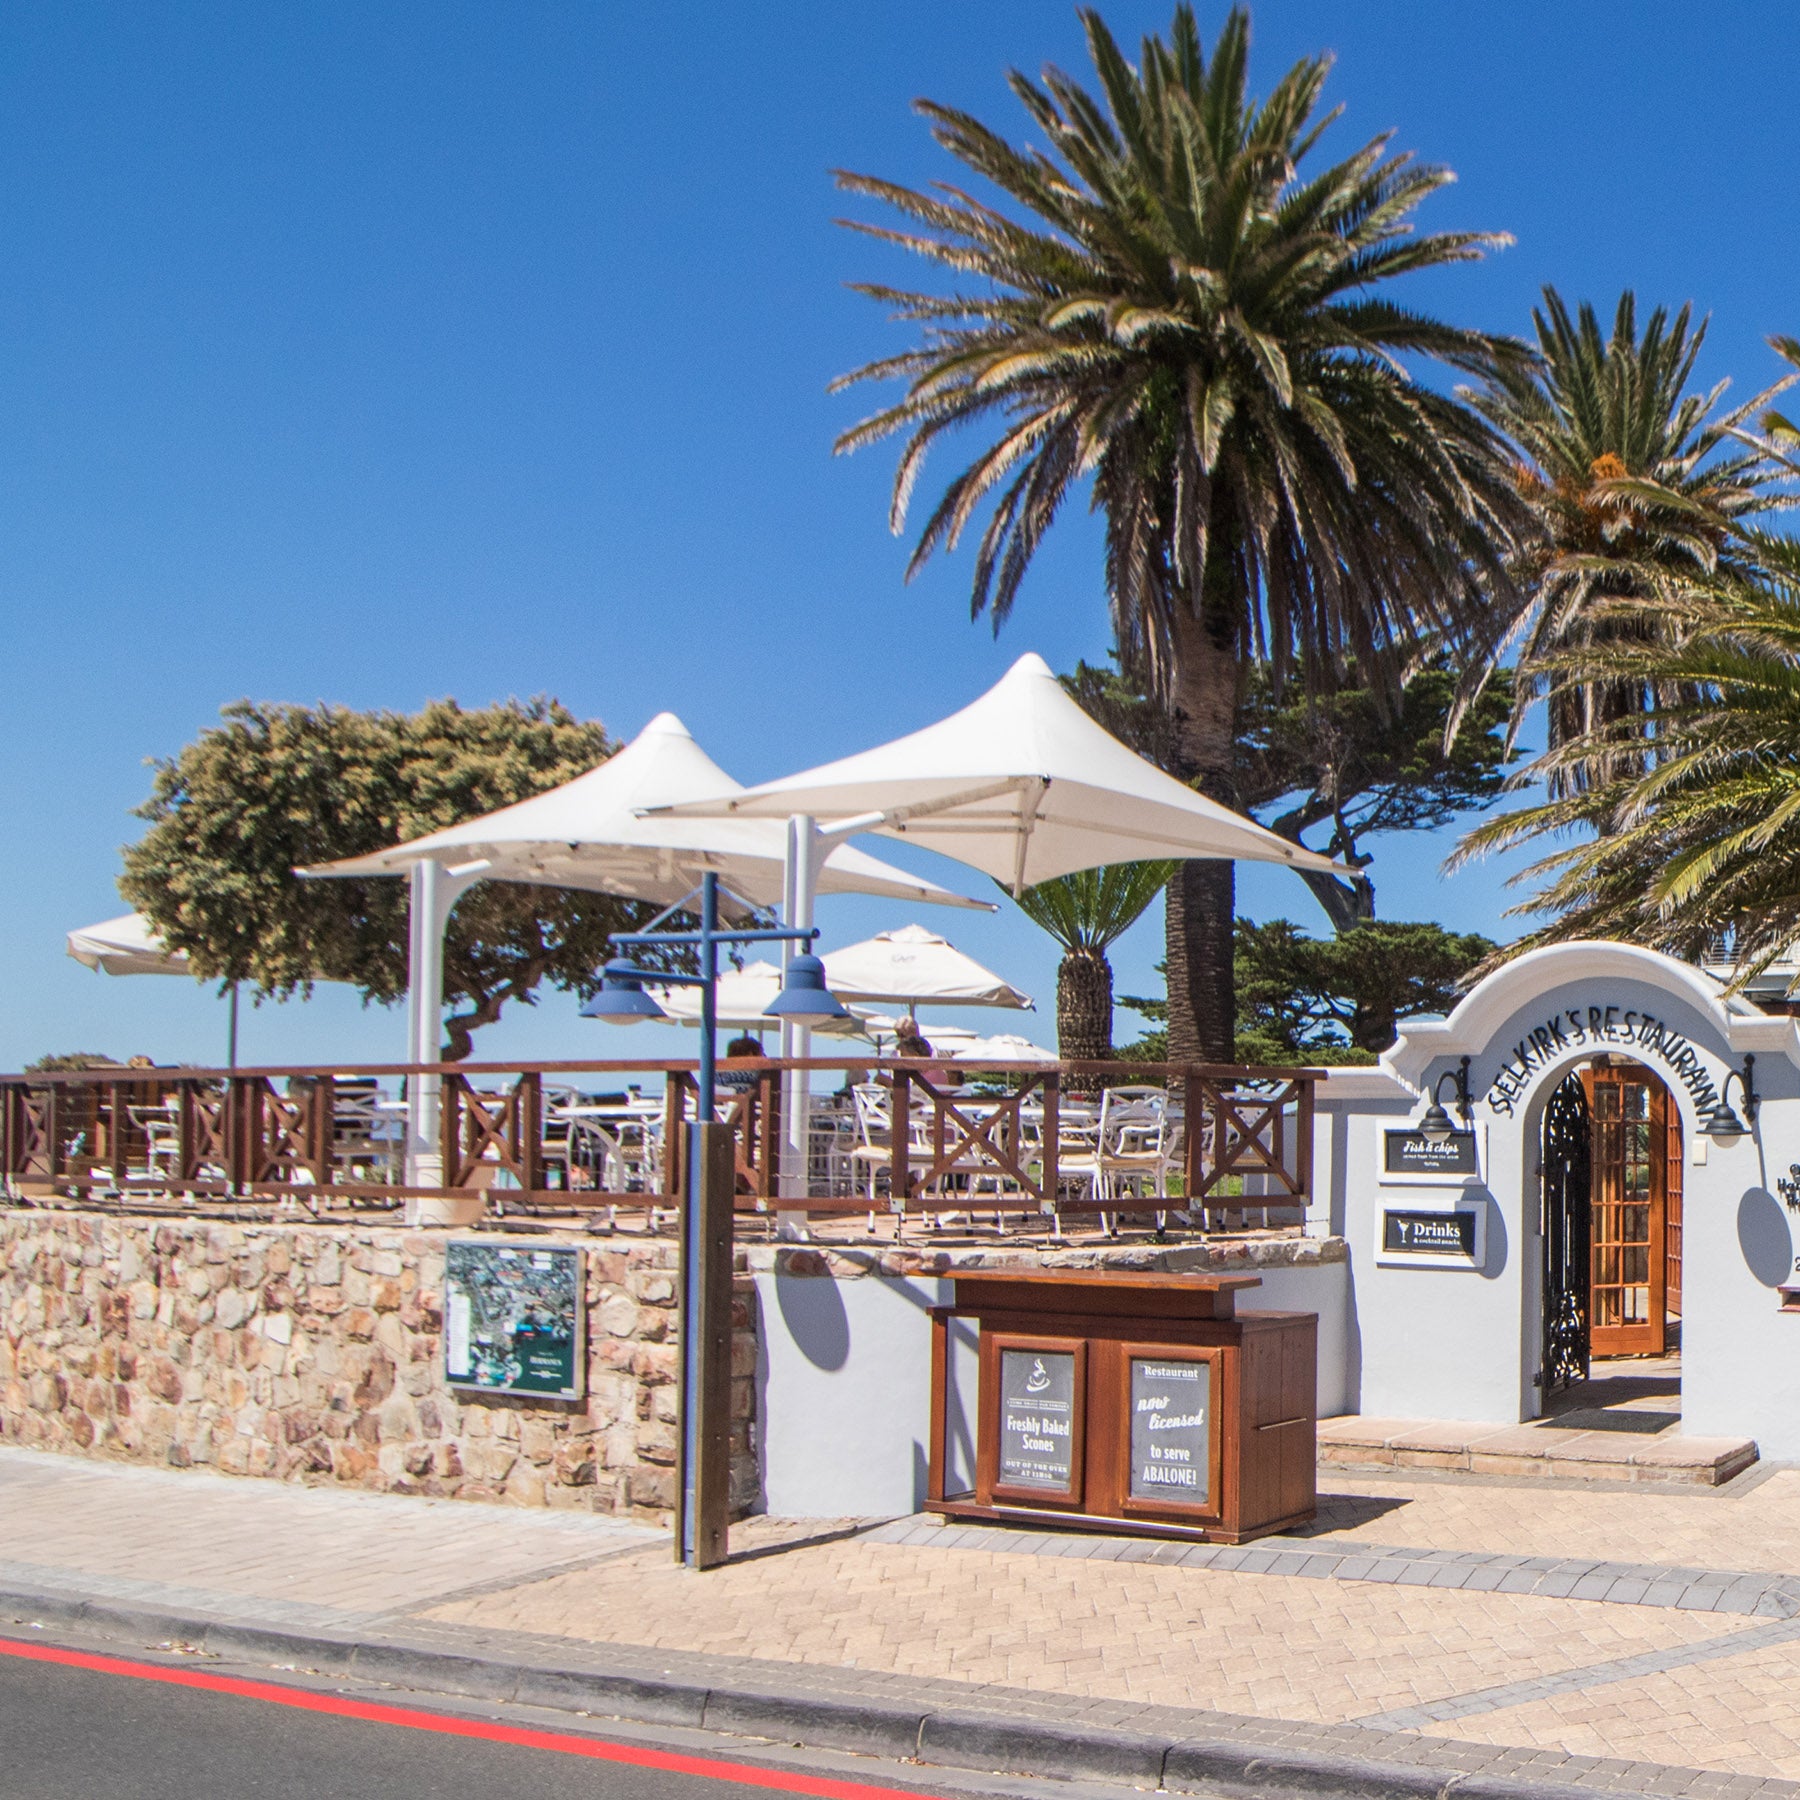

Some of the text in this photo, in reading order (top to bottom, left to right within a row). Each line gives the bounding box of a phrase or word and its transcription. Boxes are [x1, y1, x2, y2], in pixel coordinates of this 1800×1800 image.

[1488, 1006, 1720, 1117] SELKIRK'S RESTAURANT
[1403, 1141, 1425, 1152] Fish
[1434, 1141, 1459, 1155] chips
[1413, 1222, 1460, 1238] Drinks
[1144, 1365, 1198, 1378] Restaurant
[1137, 1396, 1170, 1411] now
[1007, 1415, 1070, 1436] Freshly Baked
[1149, 1408, 1204, 1430] licensed
[1022, 1434, 1055, 1453] Scones
[1150, 1444, 1190, 1461] to serve
[1006, 1460, 1021, 1468] OUT
[1142, 1466, 1197, 1485] ABALONE!
